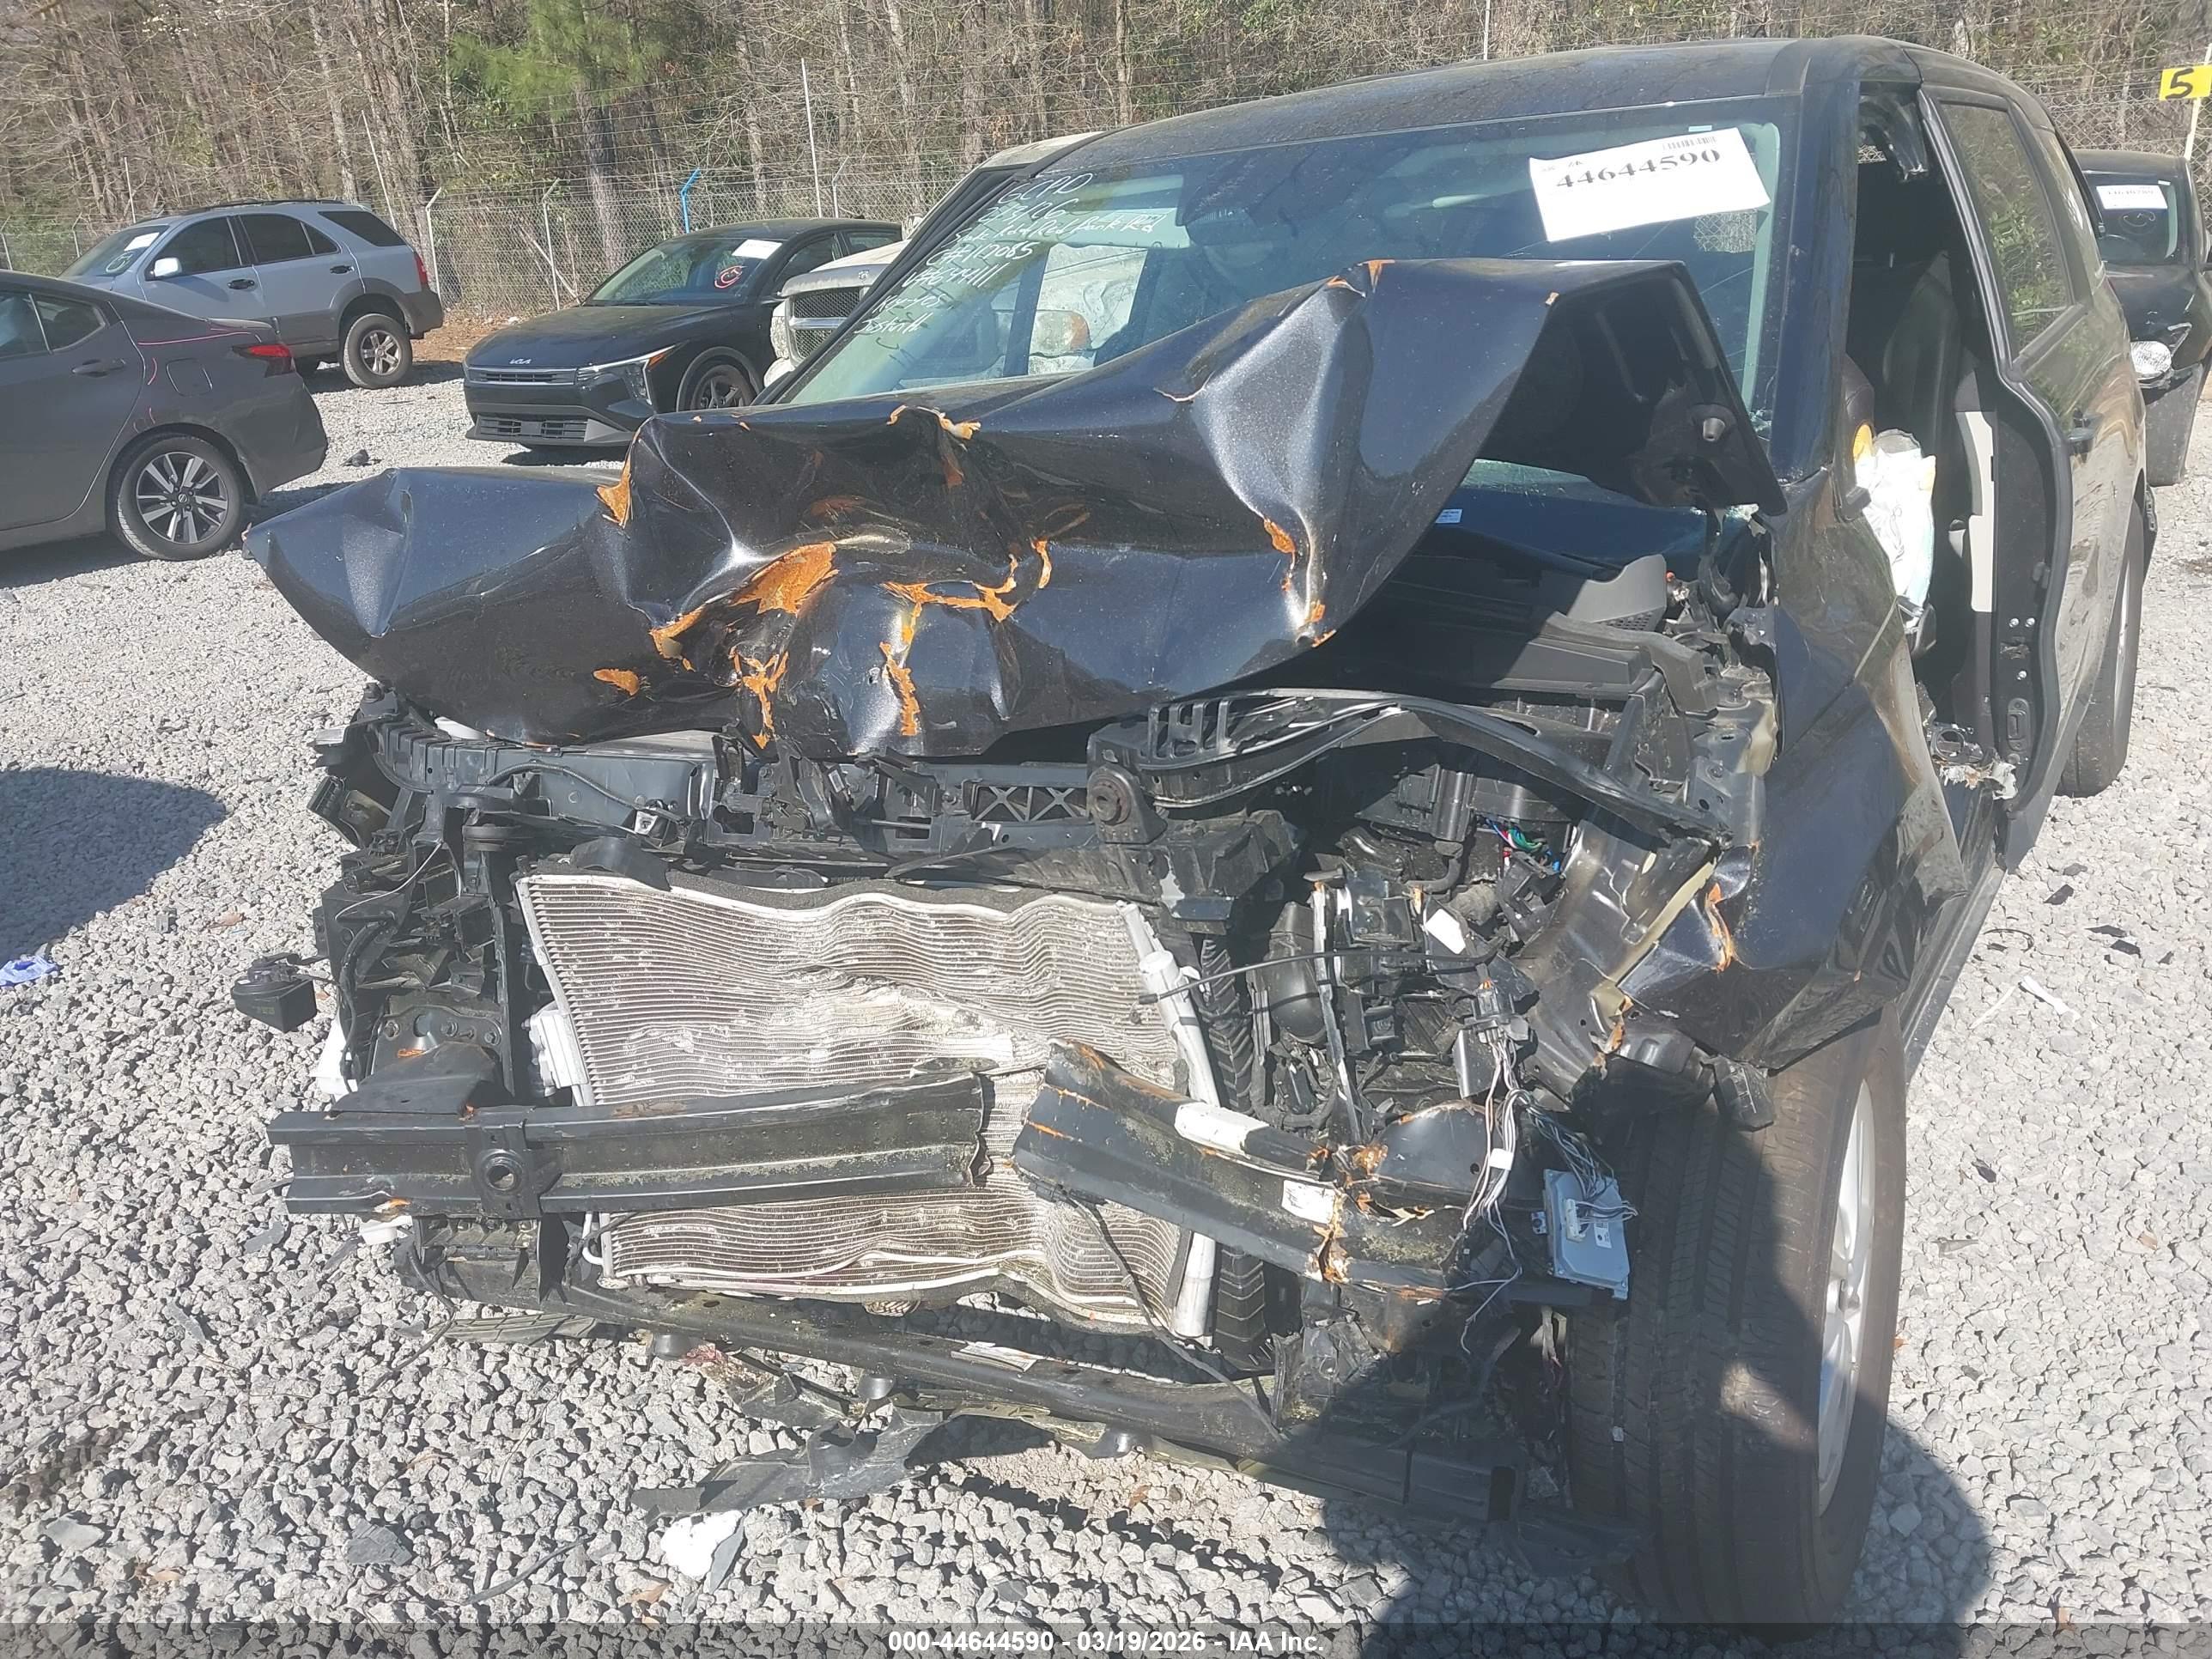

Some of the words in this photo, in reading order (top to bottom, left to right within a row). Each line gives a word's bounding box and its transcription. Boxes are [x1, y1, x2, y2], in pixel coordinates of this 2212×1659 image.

[2165, 67, 2194, 100] 5
[1556, 149, 1721, 188] 44644590
[998, 173, 1093, 204] GCPD
